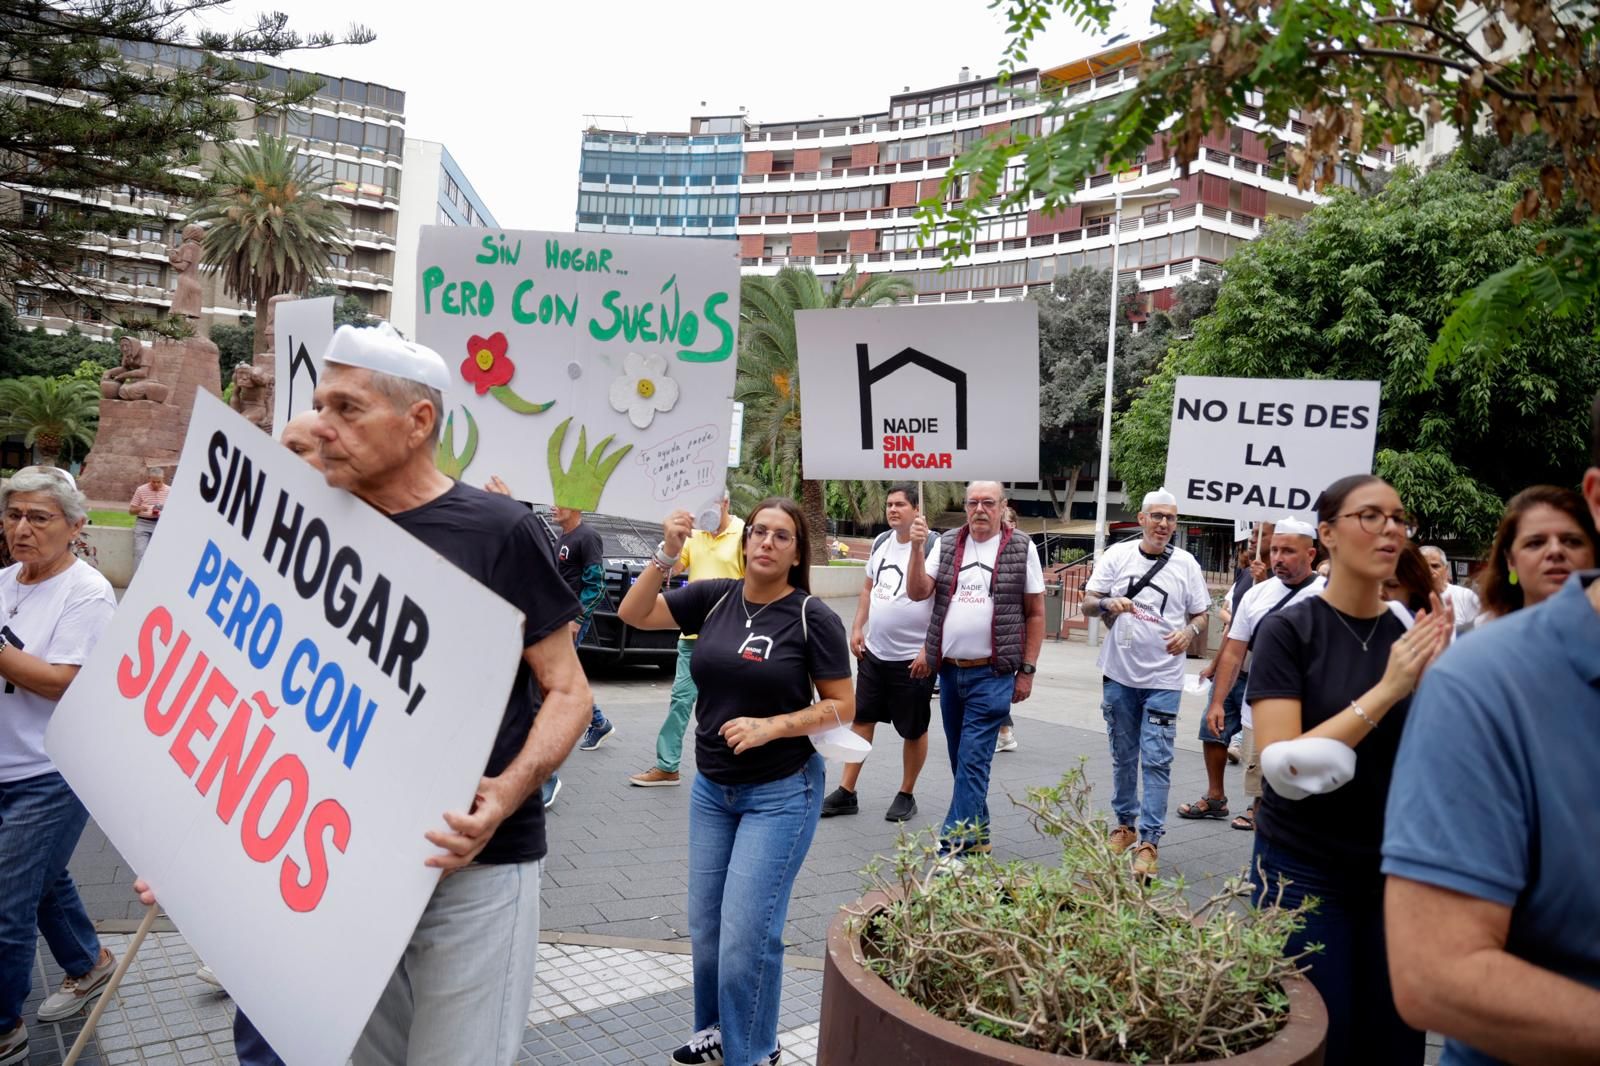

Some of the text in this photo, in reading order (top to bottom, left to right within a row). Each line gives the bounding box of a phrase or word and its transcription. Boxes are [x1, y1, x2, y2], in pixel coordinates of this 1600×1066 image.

[422, 265, 495, 317] PERO
[511, 278, 579, 326] CON
[883, 418, 938, 434] NADIE
[1177, 398, 1370, 430] NO LES DES
[883, 435, 915, 452] SIN
[1244, 443, 1286, 468] LA
[653, 453, 691, 475] cambiar
[883, 452, 953, 469] HOGAR
[666, 469, 687, 482] una
[199, 430, 430, 716] SIN HOGAR,
[187, 539, 379, 769] PERO CON
[117, 605, 351, 914] SUEÑOS
